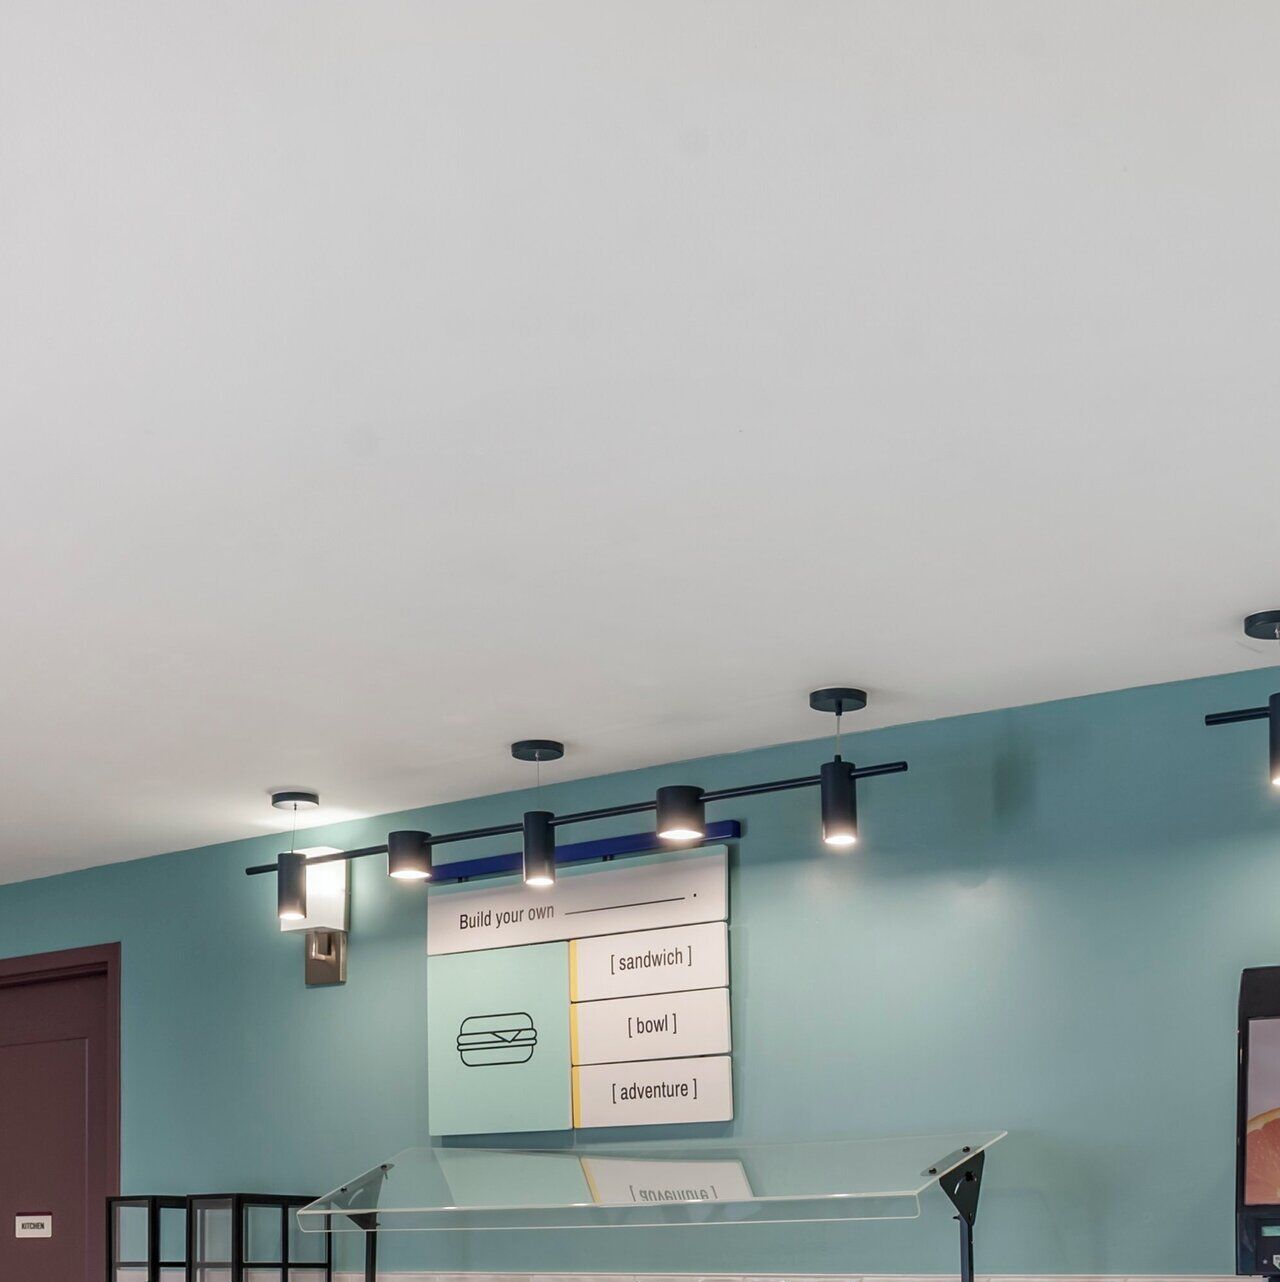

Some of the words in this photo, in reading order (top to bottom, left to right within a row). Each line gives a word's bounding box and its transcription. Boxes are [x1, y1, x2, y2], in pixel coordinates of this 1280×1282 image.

[459, 909, 492, 930] Build
[495, 907, 525, 929] your
[528, 904, 555, 922] own
[619, 947, 683, 971] sandwich
[636, 1014, 669, 1034] bowl
[620, 1081, 689, 1101] adventure
[21, 1222, 45, 1230] KITCHEN
